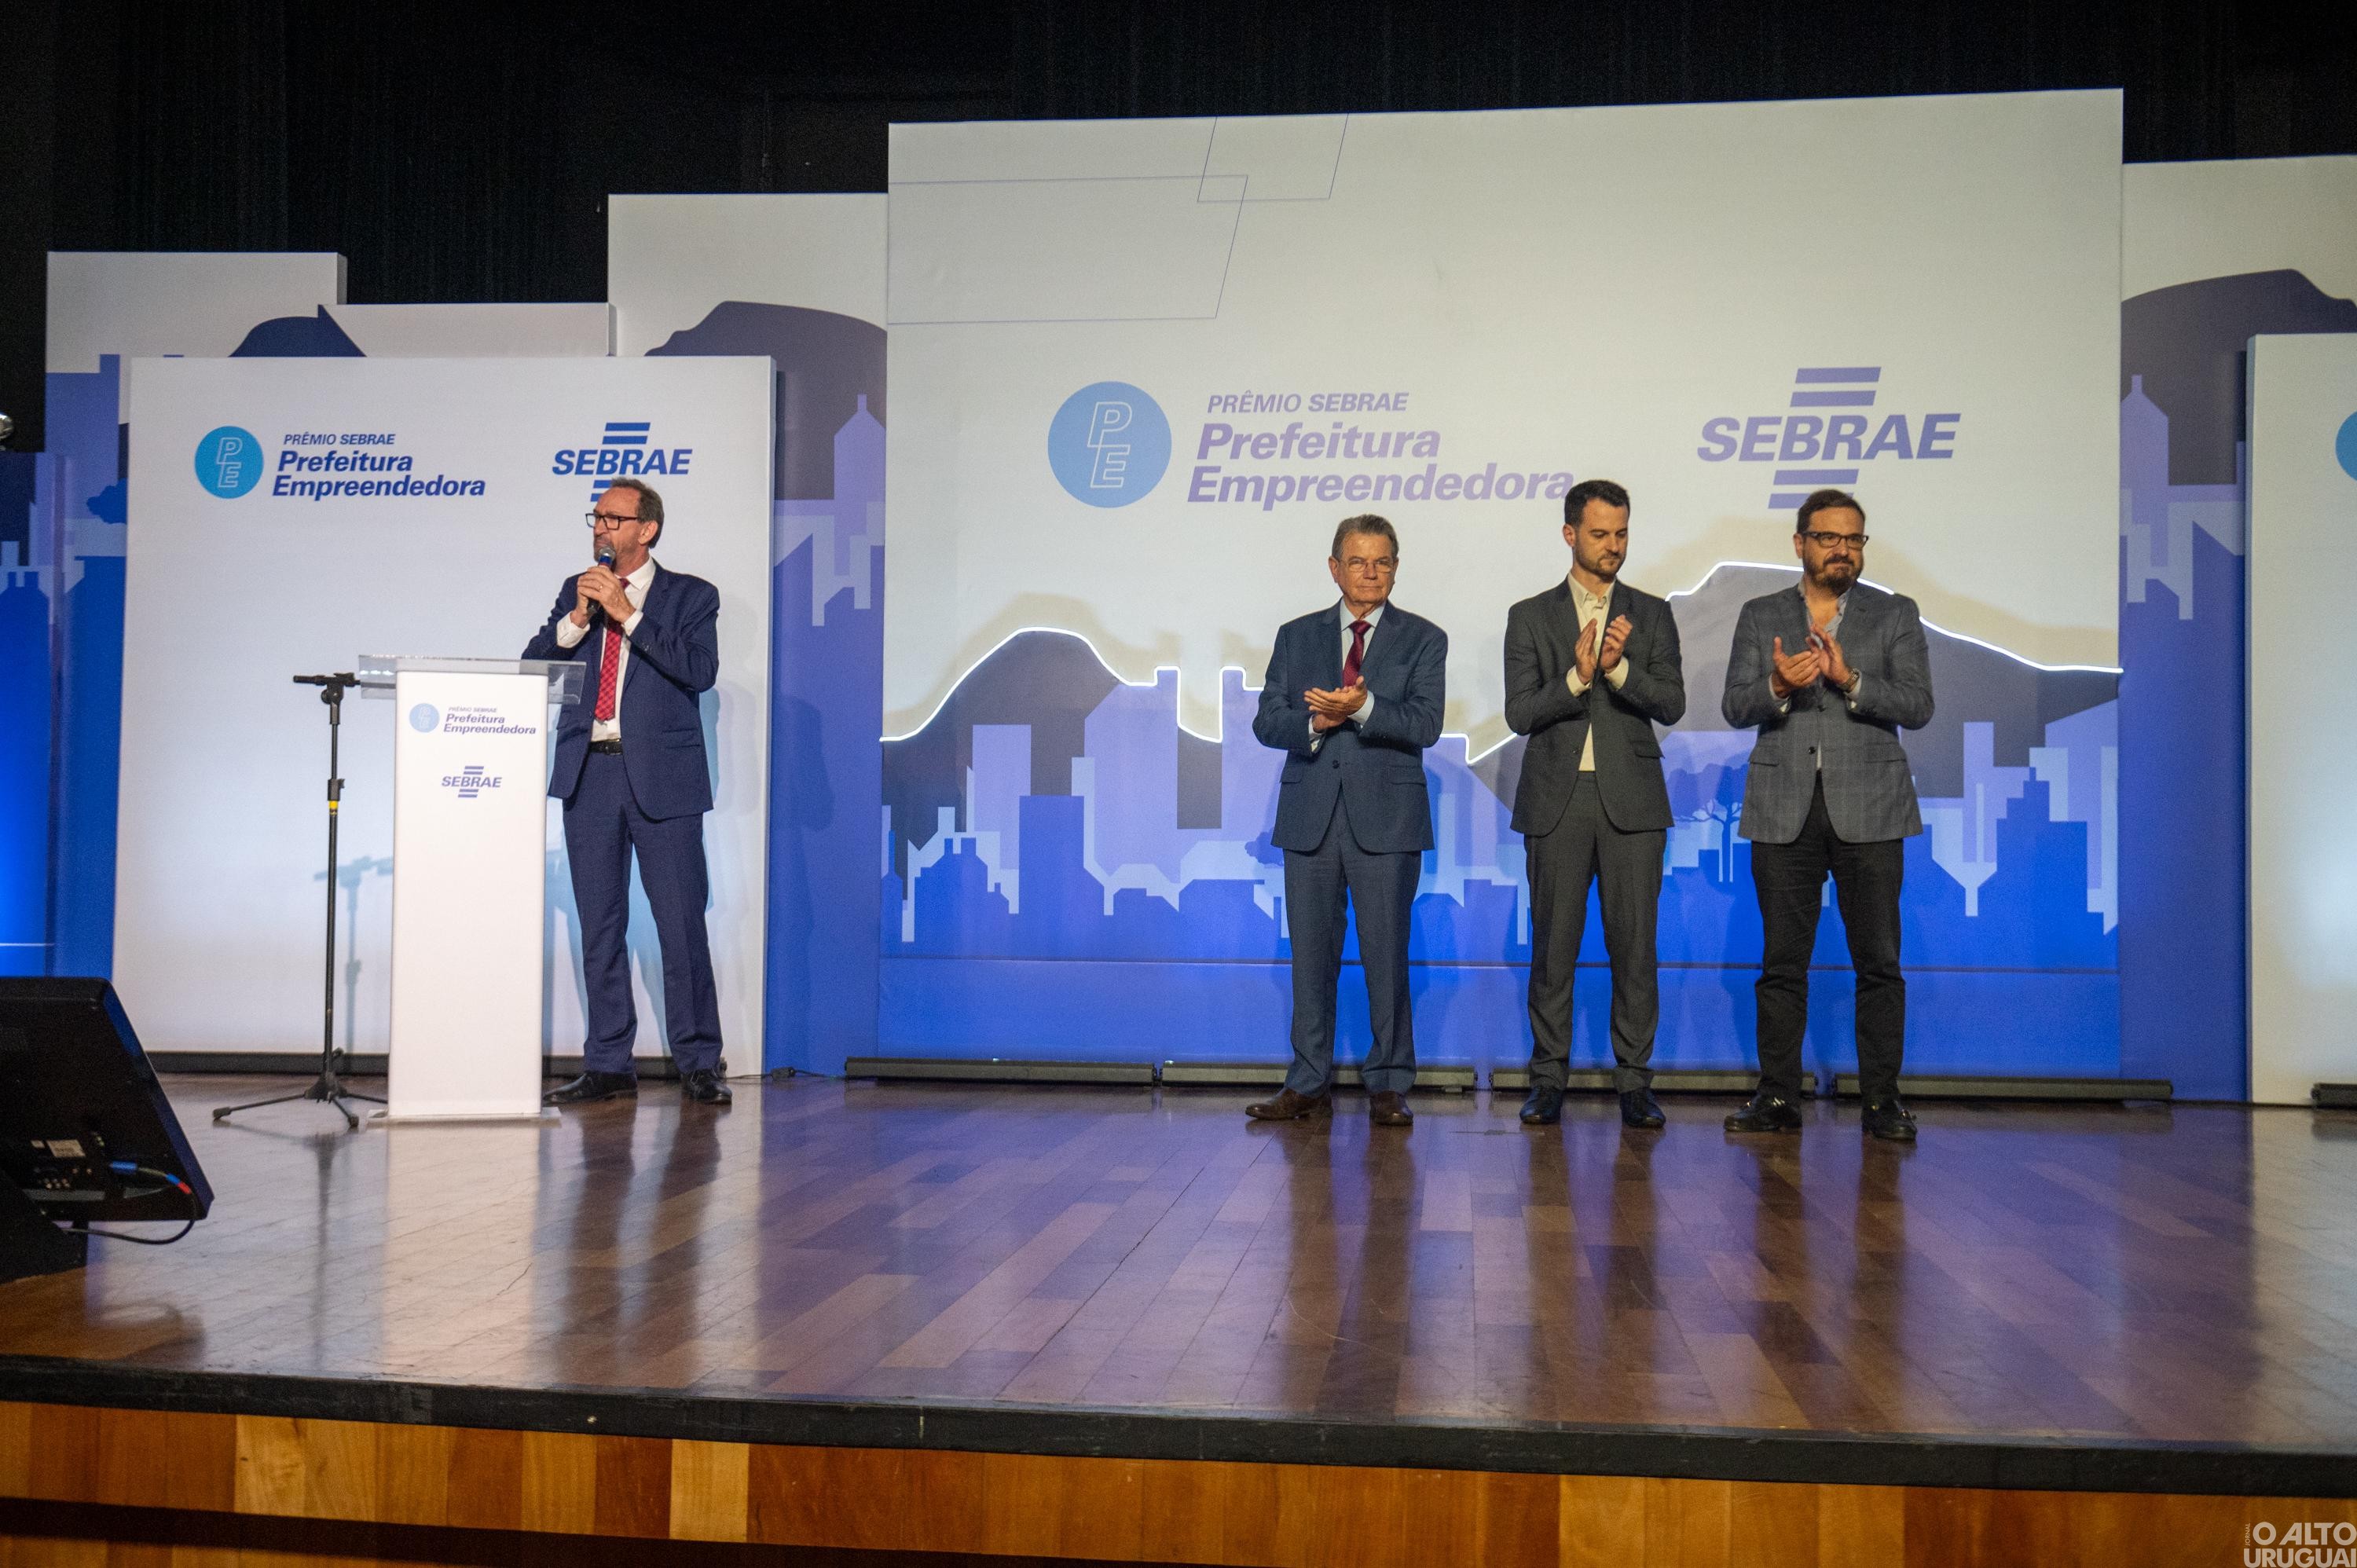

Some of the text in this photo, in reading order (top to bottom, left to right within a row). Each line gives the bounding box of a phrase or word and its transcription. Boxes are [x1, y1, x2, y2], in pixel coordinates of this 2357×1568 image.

[1207, 390, 1409, 413] PRÊMIO SEBRAE
[284, 431, 396, 445] PRÊMIO SEBRAE
[1197, 421, 1441, 460] Prefeitura
[1697, 413, 1961, 462] SEBRAE
[277, 449, 413, 471] Prefeitura
[552, 449, 692, 475] SEBRAE
[272, 474, 486, 501] Empreendedora
[1187, 463, 1574, 511] Empreendedora
[443, 724, 536, 735] Empreendedora
[446, 713, 505, 724] Prefeitura
[442, 776, 502, 787] SEBRAE
